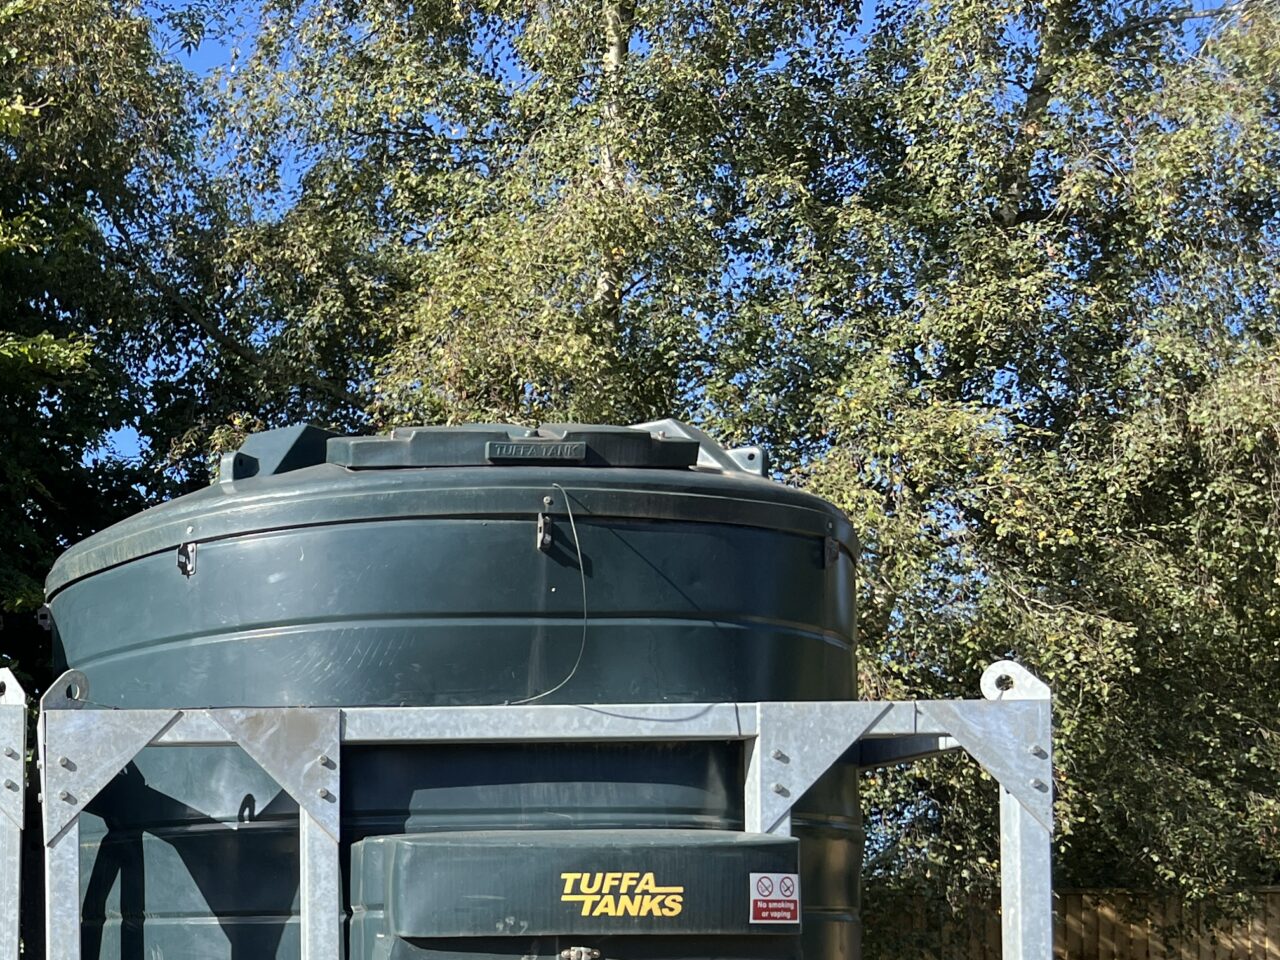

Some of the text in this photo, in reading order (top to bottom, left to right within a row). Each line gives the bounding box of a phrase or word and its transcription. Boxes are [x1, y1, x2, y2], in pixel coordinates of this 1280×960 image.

[494, 444, 580, 458] TUFFA TANK
[560, 872, 684, 894] TUFFA
[560, 894, 684, 916] TANKS
[768, 901, 795, 910] smoking
[770, 911, 791, 919] vaping
